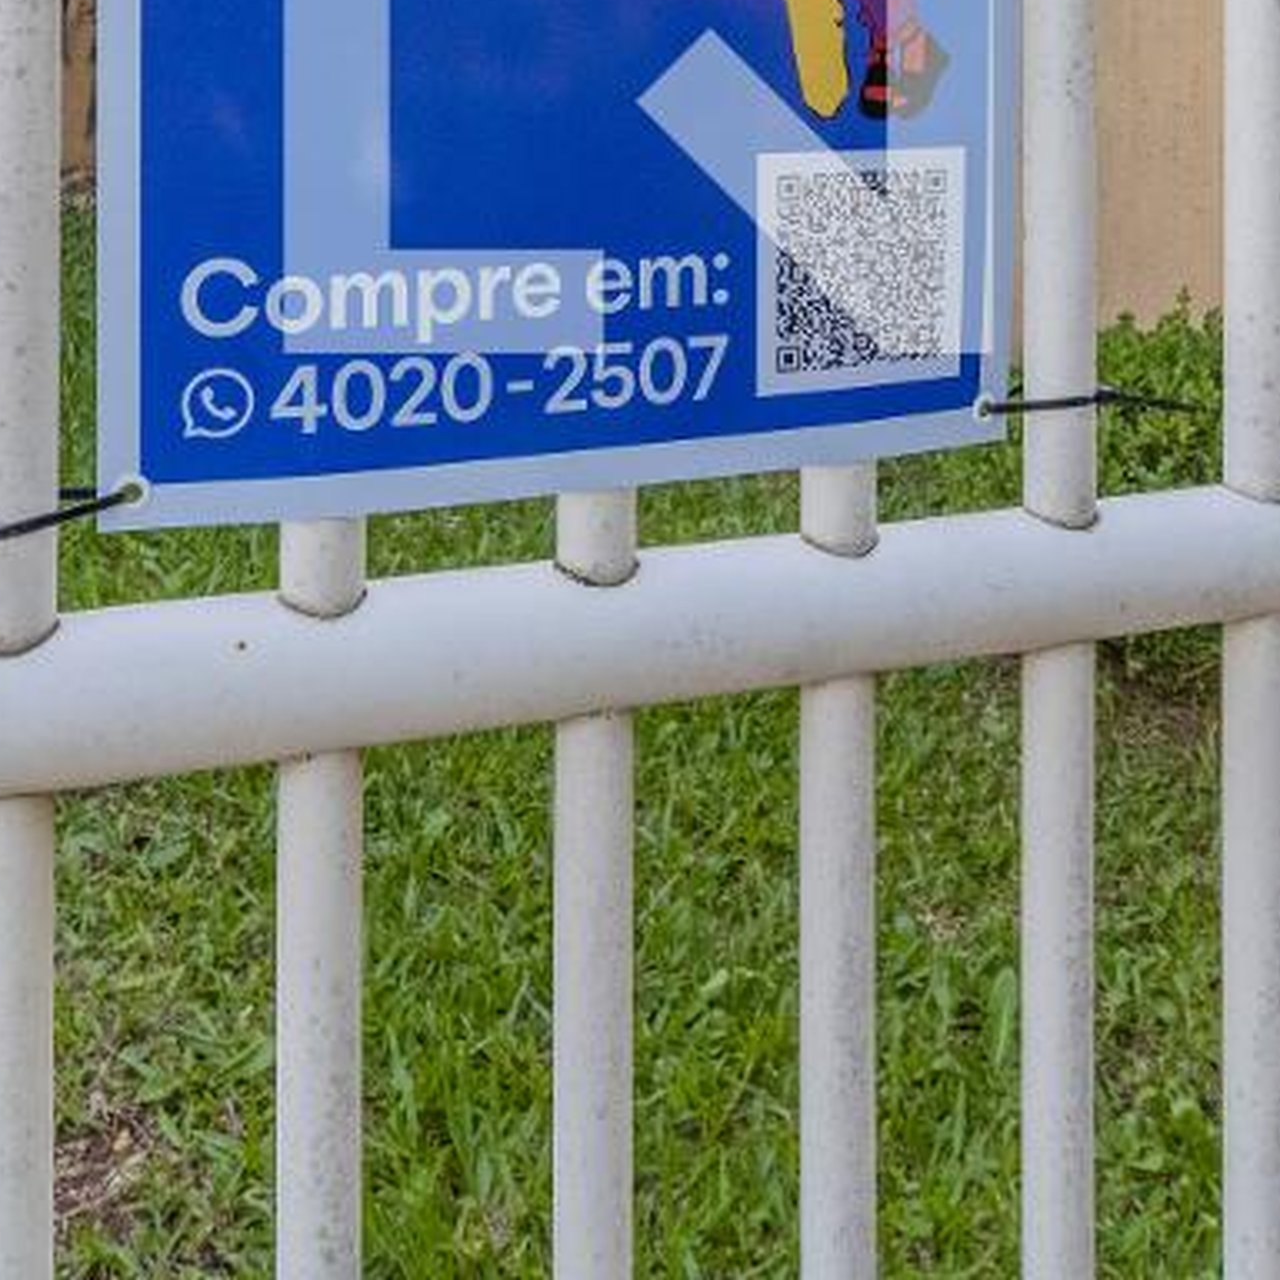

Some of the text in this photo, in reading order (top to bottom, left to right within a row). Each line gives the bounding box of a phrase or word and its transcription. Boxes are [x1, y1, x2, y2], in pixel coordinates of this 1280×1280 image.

[180, 251, 732, 343] Compre em:
[269, 334, 729, 436] 4020-2507
